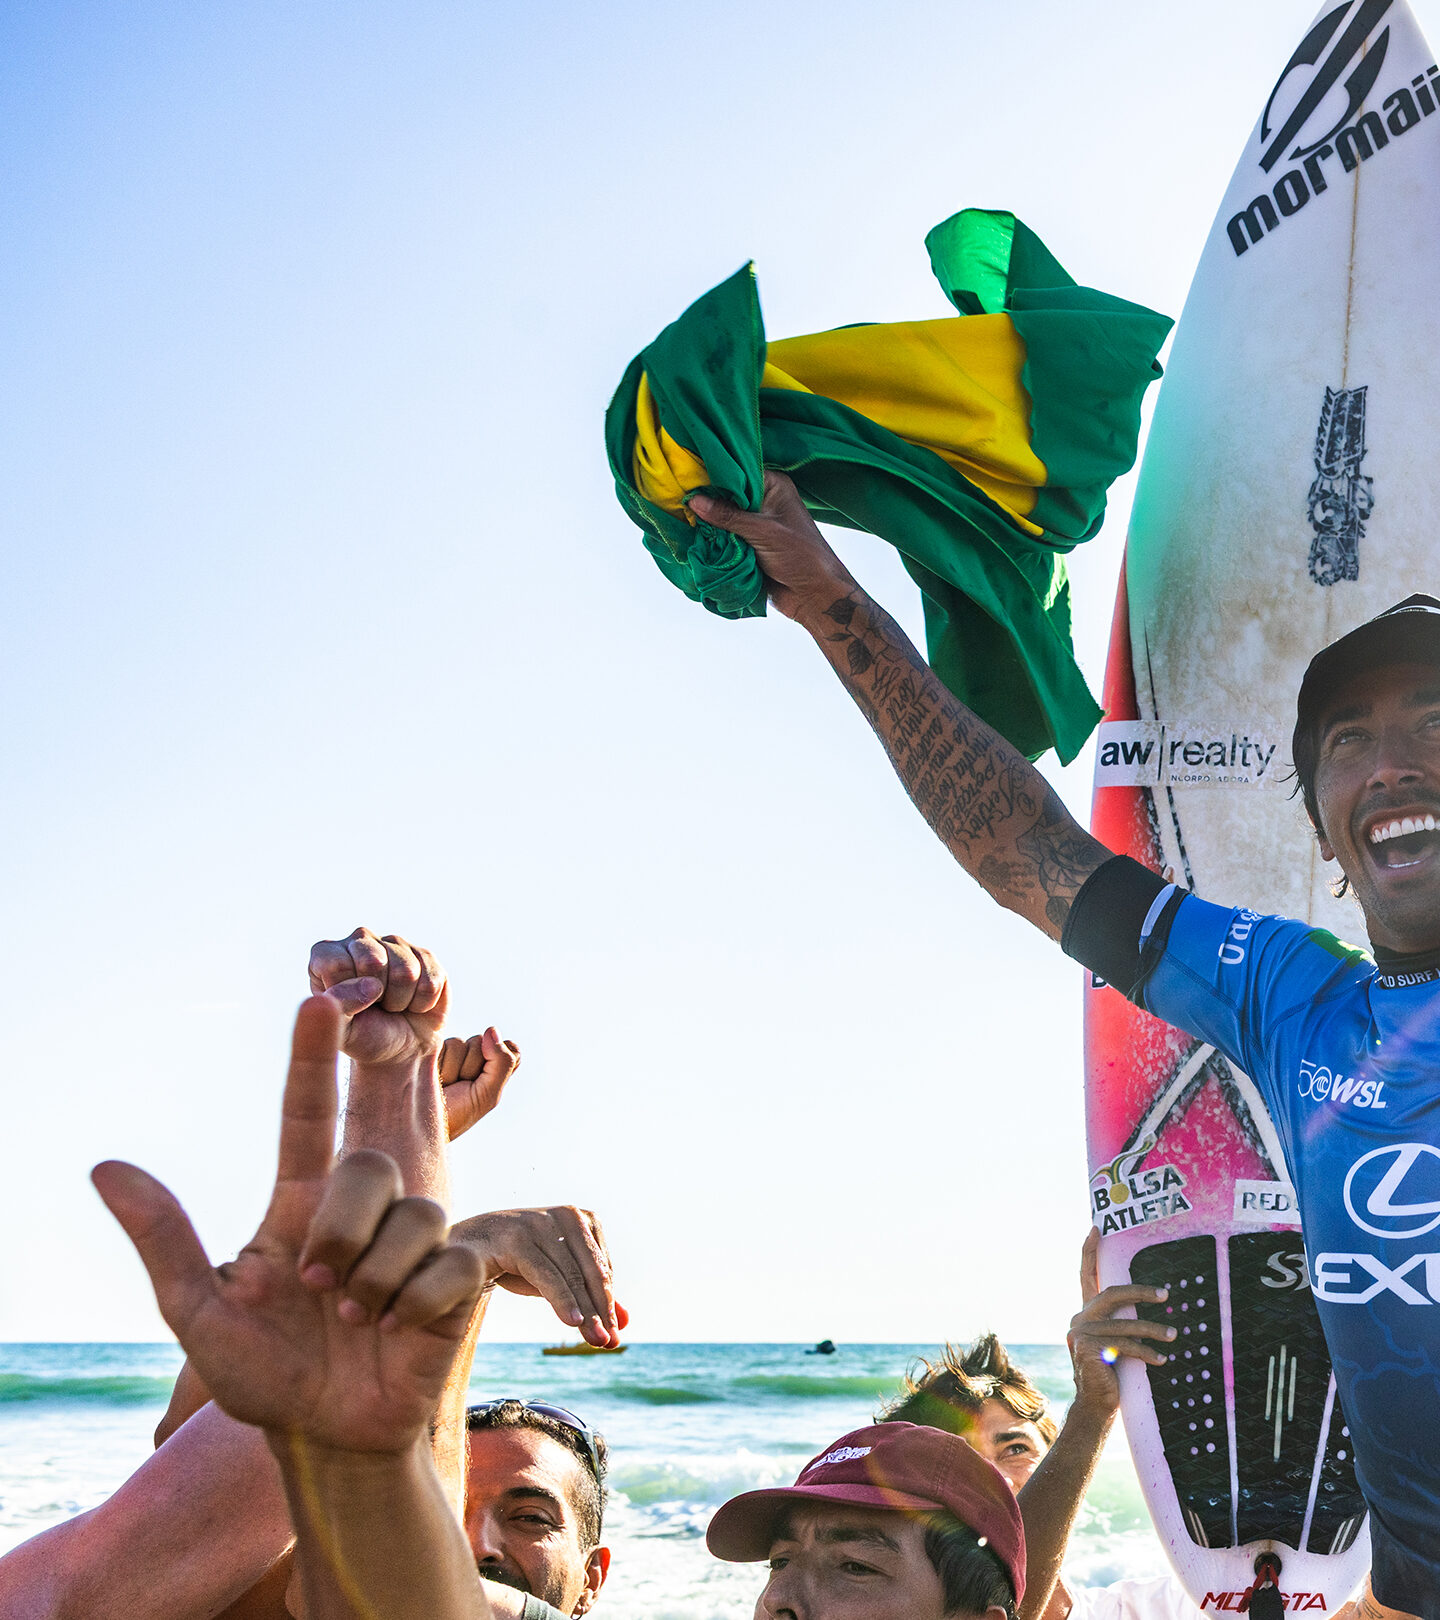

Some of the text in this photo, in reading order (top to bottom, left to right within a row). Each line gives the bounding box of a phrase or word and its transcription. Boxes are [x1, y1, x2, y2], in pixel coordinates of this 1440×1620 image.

[1100, 734, 1277, 777] aw realty
[1397, 970, 1433, 987] SURF
[1331, 1074, 1386, 1109] WSL
[1102, 1192, 1190, 1236] ATLETA
[1242, 1191, 1300, 1212] RED
